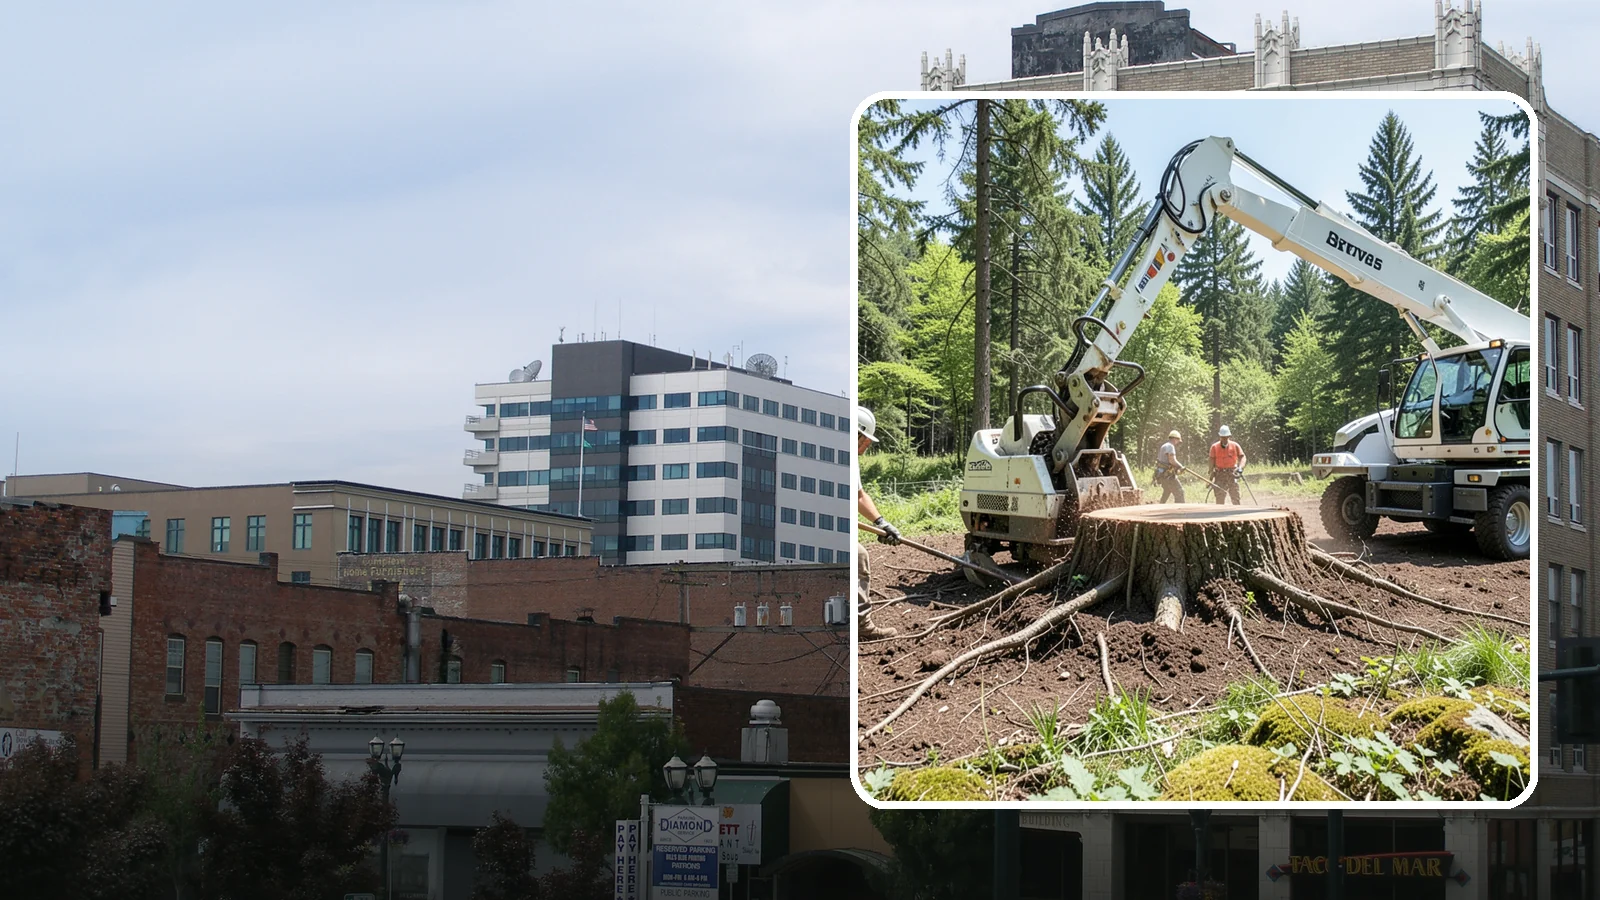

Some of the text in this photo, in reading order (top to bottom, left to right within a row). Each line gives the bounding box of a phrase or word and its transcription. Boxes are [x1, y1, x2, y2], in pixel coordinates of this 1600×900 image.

[370, 565, 427, 577] Furnishers
[660, 818, 713, 833] DIAMOND
[1021, 814, 1070, 828] BUILDING
[617, 824, 625, 852] PAY
[628, 824, 637, 852] PAY
[655, 845, 716, 854] RESERVED PARKING
[671, 862, 701, 870] PATRONS
[1289, 855, 1443, 877] TAC DEL MAR
[616, 856, 625, 894] HERE
[627, 856, 636, 893] HERE
[660, 889, 710, 898] PUBLIC PARKING
